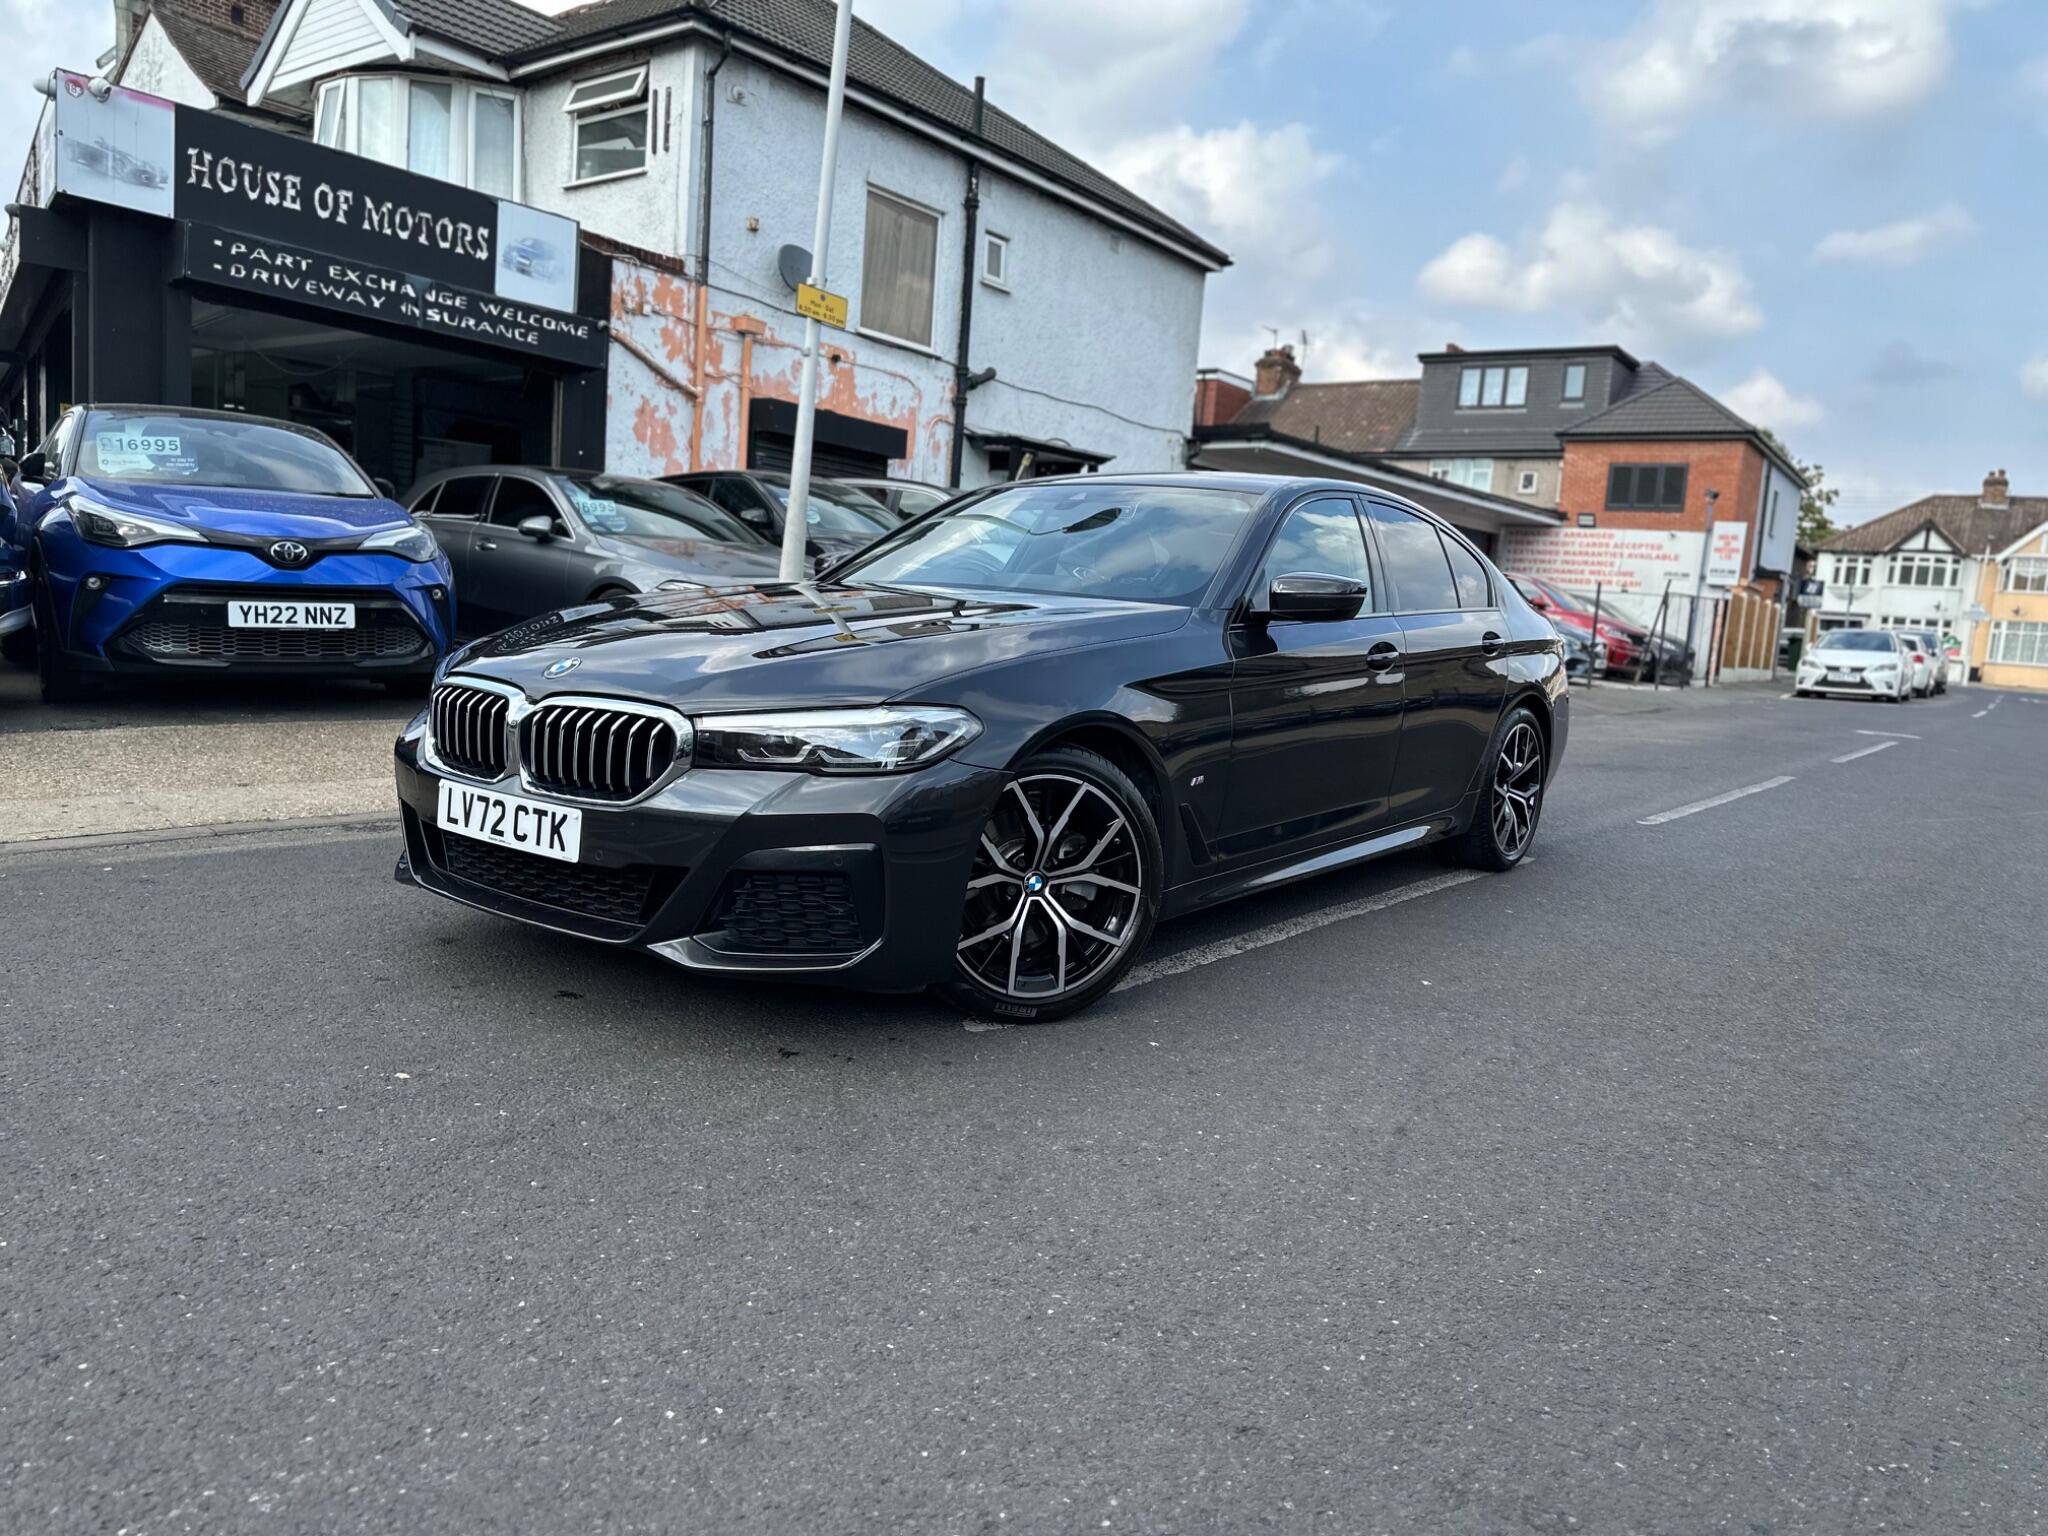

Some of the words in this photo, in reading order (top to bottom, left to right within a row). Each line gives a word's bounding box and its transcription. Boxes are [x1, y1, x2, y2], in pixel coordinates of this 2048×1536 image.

[187, 147, 302, 211] HOUSE
[313, 182, 353, 224] OF
[362, 195, 490, 261] MOTORS
[230, 262, 386, 309] DRIVEWAY
[230, 241, 313, 271] PART
[479, 300, 590, 339] WELCOME
[239, 604, 299, 625] YH22
[304, 605, 347, 626] NNZ
[446, 787, 507, 838] LV72
[513, 804, 569, 853] CTK
